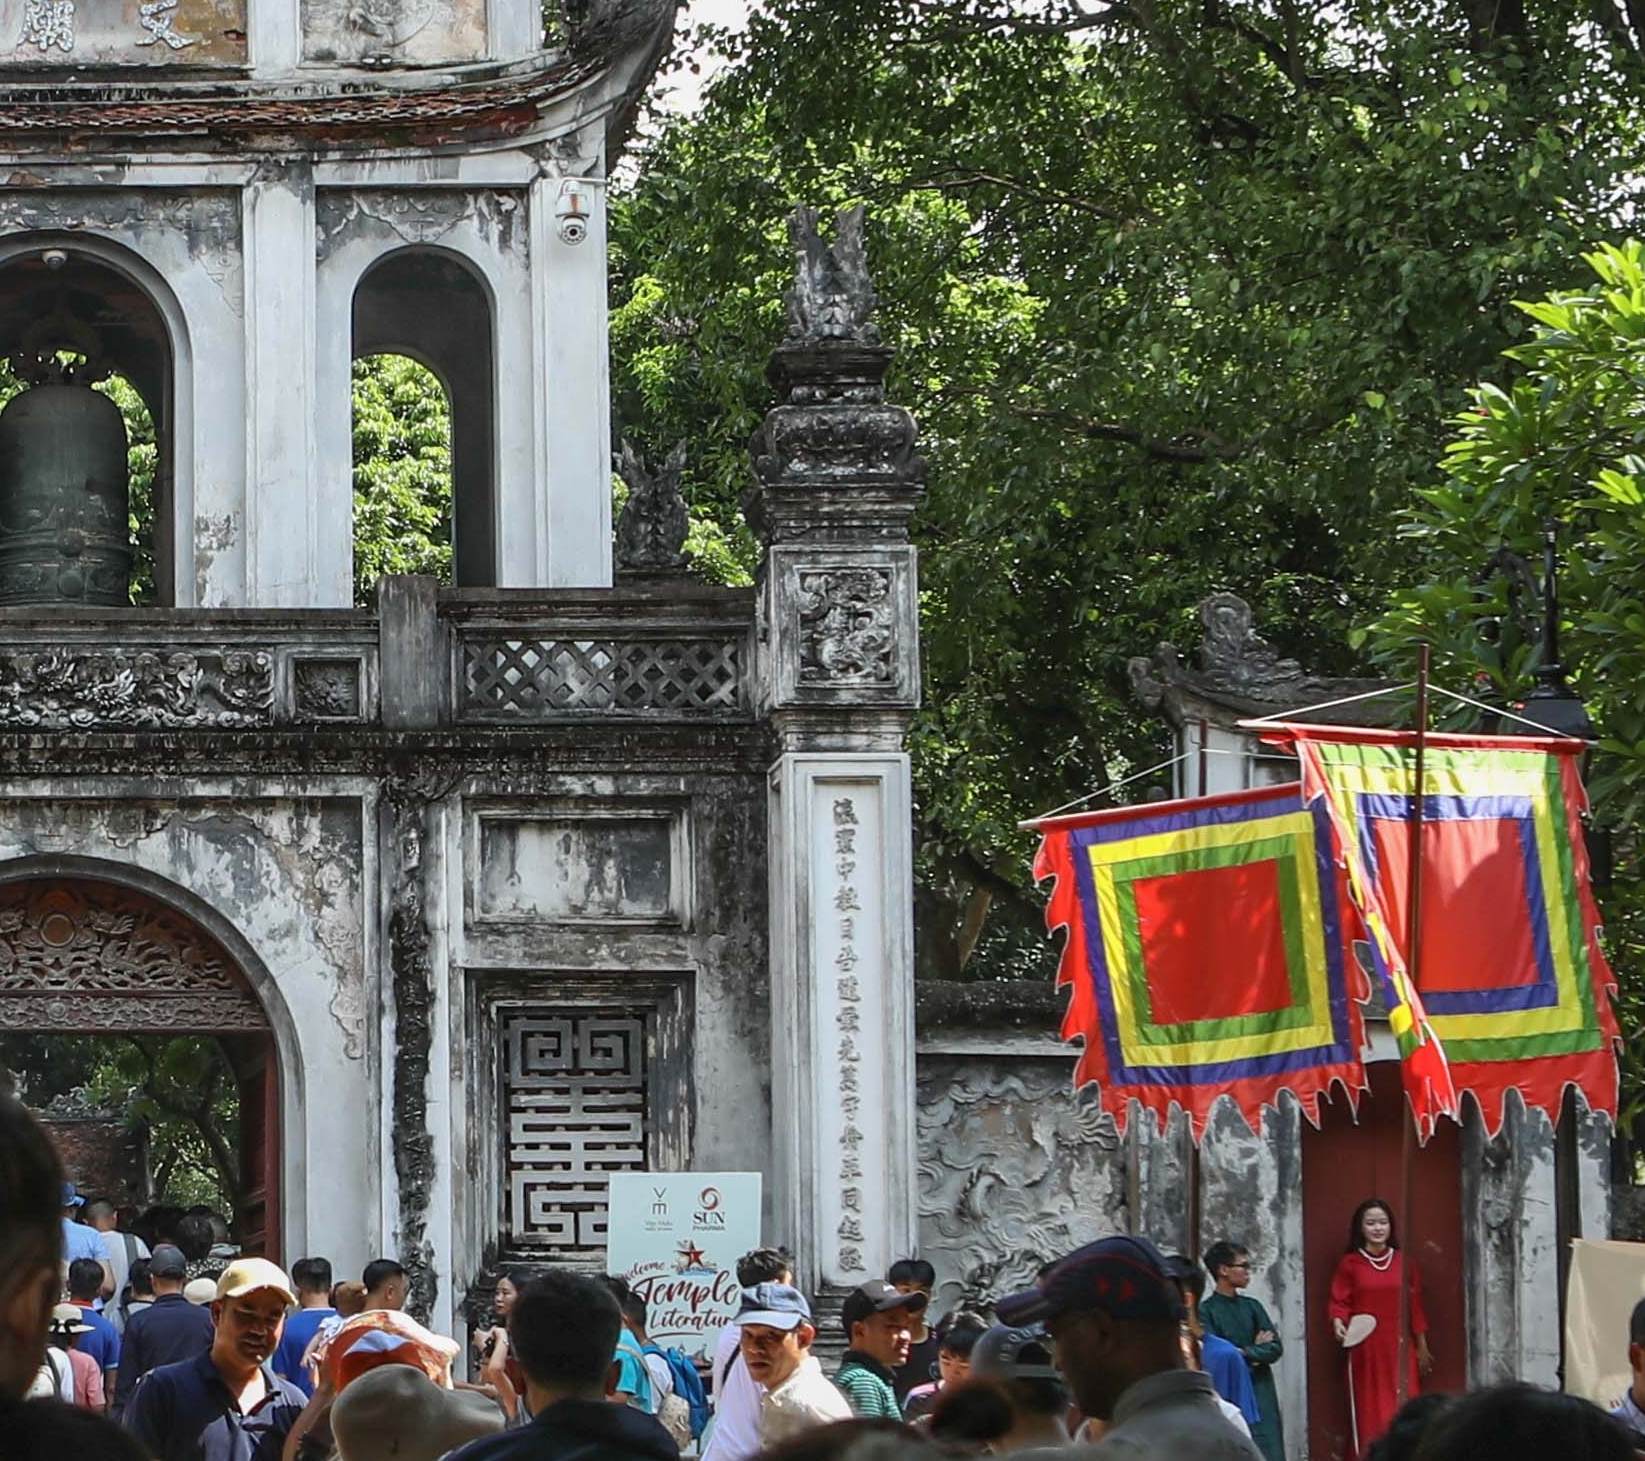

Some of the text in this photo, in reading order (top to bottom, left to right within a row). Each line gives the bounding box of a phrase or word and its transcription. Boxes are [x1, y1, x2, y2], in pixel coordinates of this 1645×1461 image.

[692, 1211, 726, 1225] SUN
[632, 1269, 738, 1314] Temple
[649, 1307, 733, 1331] Literatur
